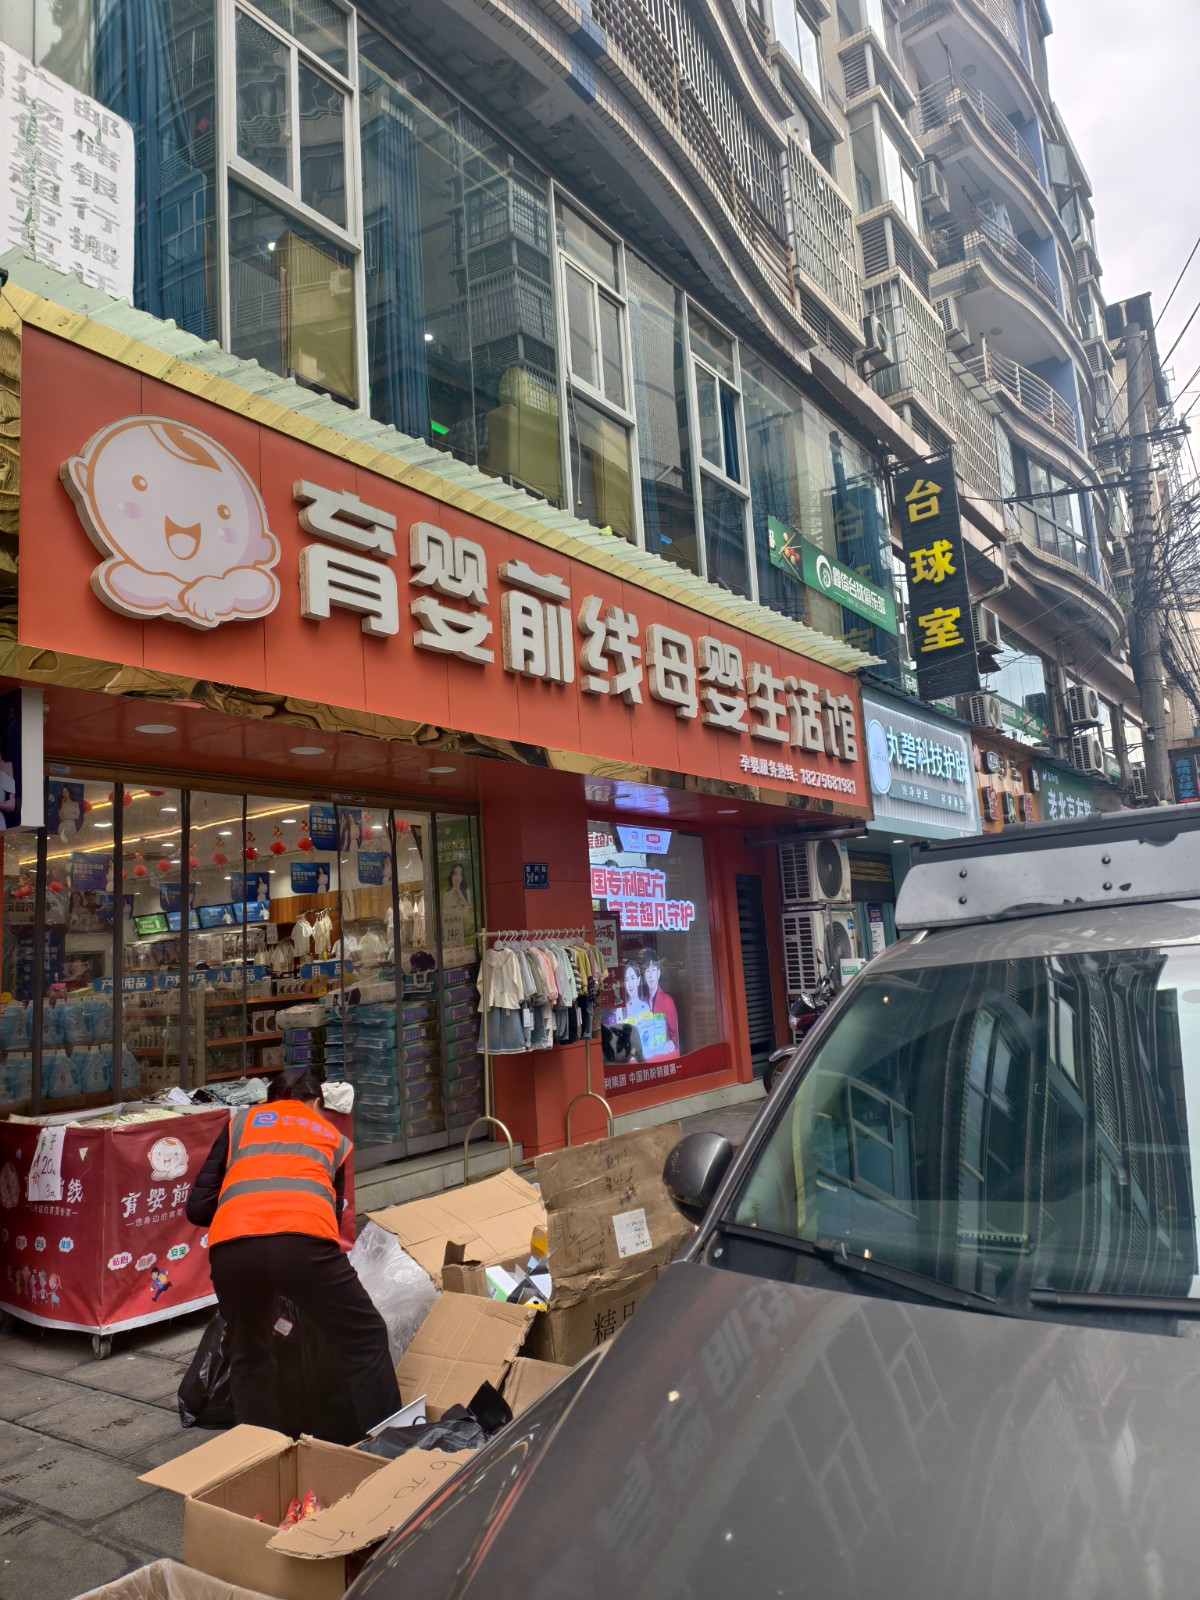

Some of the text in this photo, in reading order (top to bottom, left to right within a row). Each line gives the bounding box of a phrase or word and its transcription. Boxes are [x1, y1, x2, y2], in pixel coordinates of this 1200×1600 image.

[8, 63, 64, 268] 广场佳惠超市右
[905, 479, 964, 652] 台球室
[293, 479, 858, 762] 育婴前线母婴生活馆
[886, 726, 967, 783] 丸碧科技护肤
[800, 768, 856, 794] 18275681981
[591, 868, 664, 898] 国专利配方
[101, 976, 147, 991] 产用品
[121, 1182, 190, 1218] 育婴前
[170, 1246, 187, 1258] 安全
